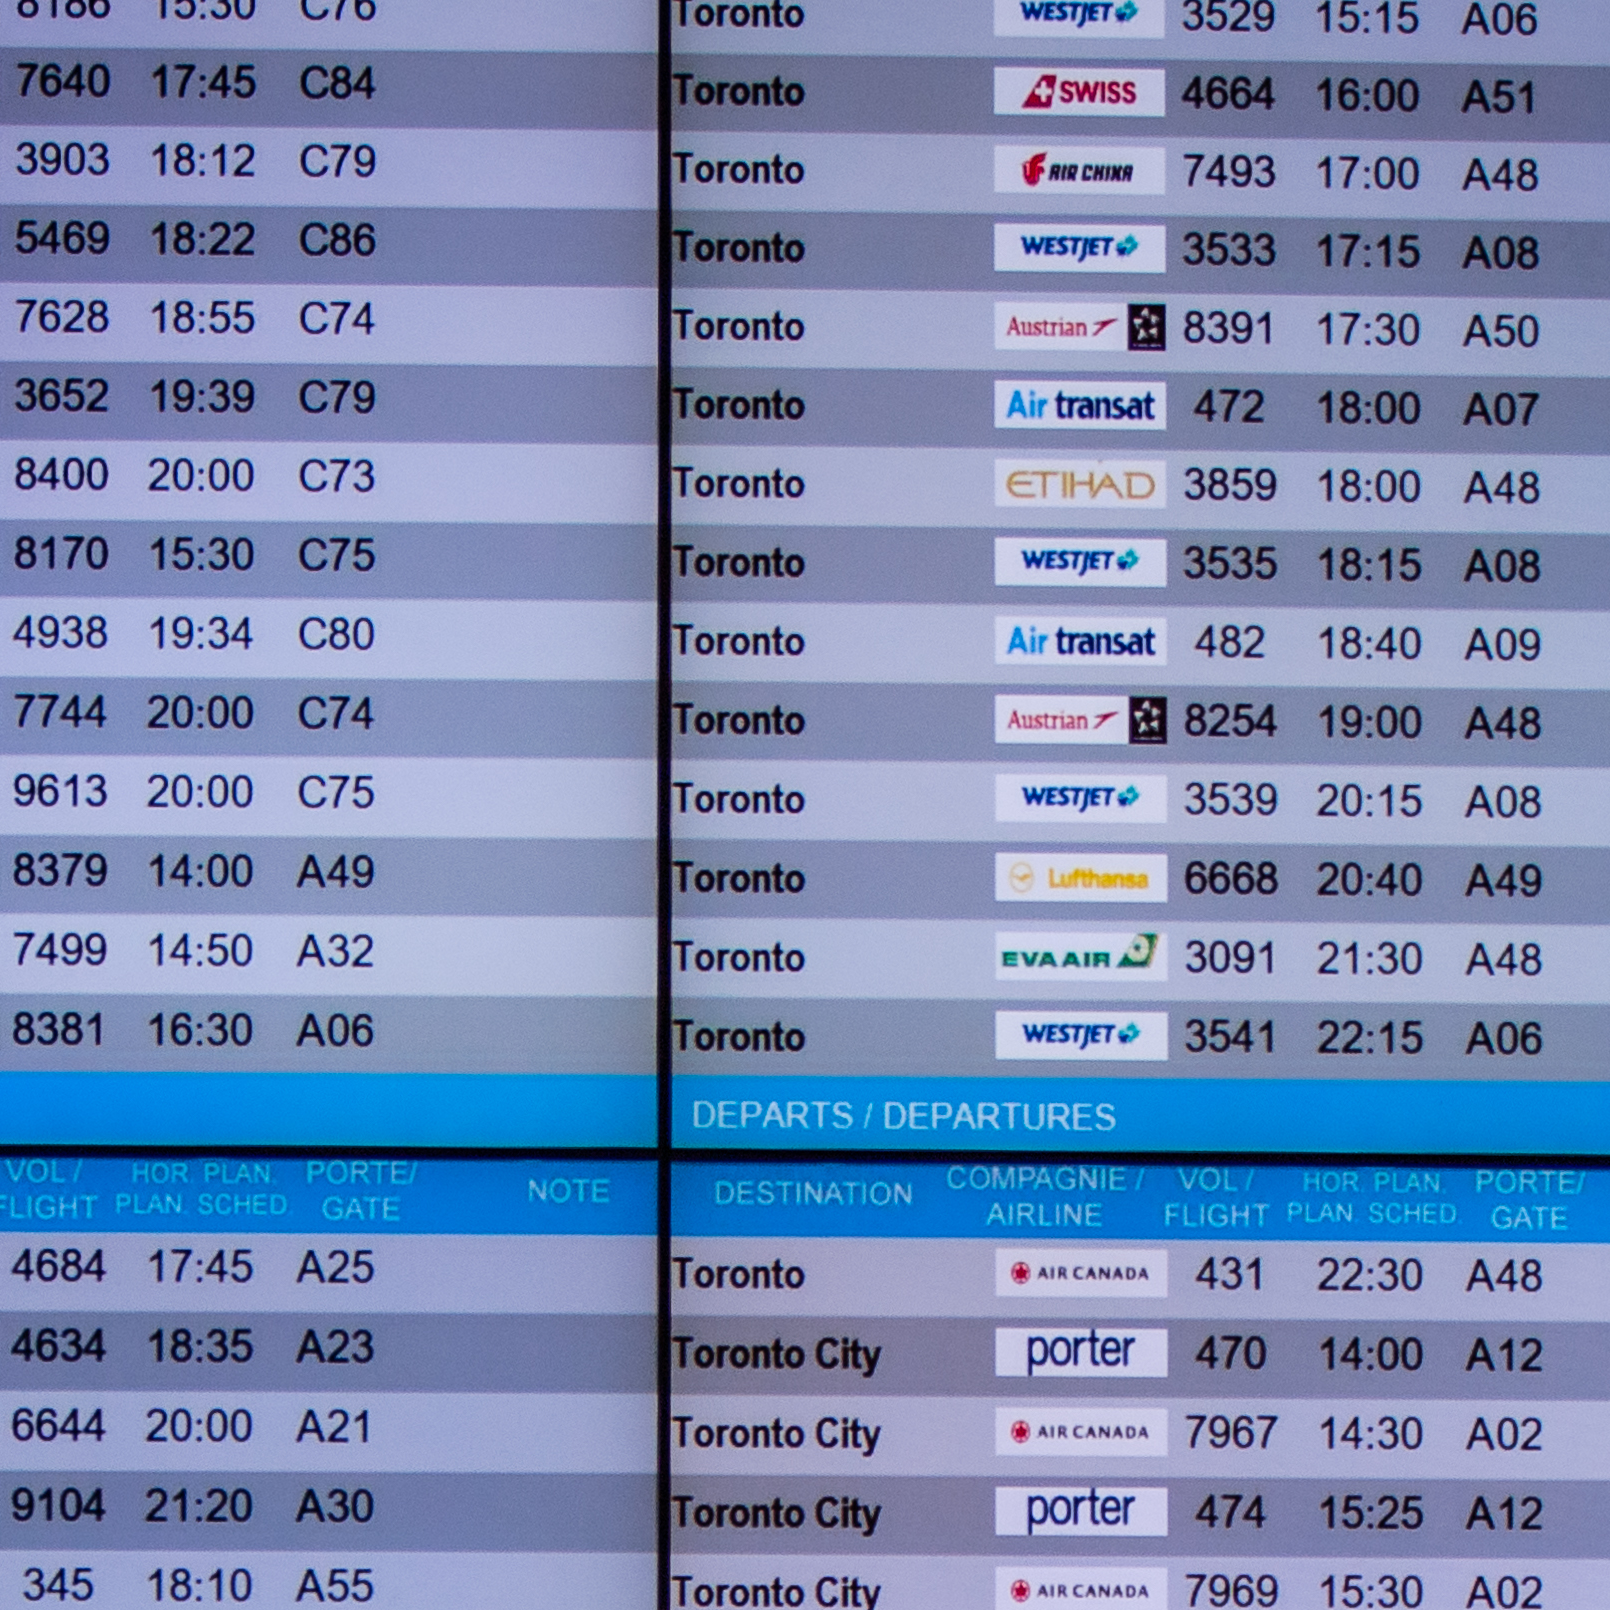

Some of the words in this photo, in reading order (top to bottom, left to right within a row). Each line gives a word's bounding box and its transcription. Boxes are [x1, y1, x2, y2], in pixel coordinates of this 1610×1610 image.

[17, 142, 109, 175] 3903
[153, 143, 255, 177] 18:12
[300, 144, 376, 178] C79
[671, 466, 805, 498] Toronto
[1006, 470, 1155, 500] ETIHAD
[1185, 467, 1277, 501] 3859
[1319, 469, 1421, 503] 18:00
[1464, 471, 1540, 504] A48
[14, 932, 107, 966] 7499
[150, 933, 253, 967] 14:50
[297, 934, 373, 967] A32
[673, 942, 805, 974] Toronto
[1062, 952, 1110, 967] AIR
[1186, 940, 1272, 973] 3091
[1318, 941, 1422, 975] 21:30
[1466, 943, 1542, 976] A48
[5, 1158, 63, 1185] VOL
[528, 1178, 609, 1203] NOTE
[322, 1196, 400, 1221] GATE
[673, 1336, 805, 1370] Toronto
[816, 1337, 881, 1378] City
[1027, 1328, 1136, 1376] porter
[1196, 1335, 1266, 1369] 470
[1321, 1337, 1423, 1371] 14:00
[1466, 1337, 1542, 1372] A12
[24, 1567, 94, 1601] 345
[149, 1568, 252, 1602] 18:10
[296, 1568, 374, 1602] A55
